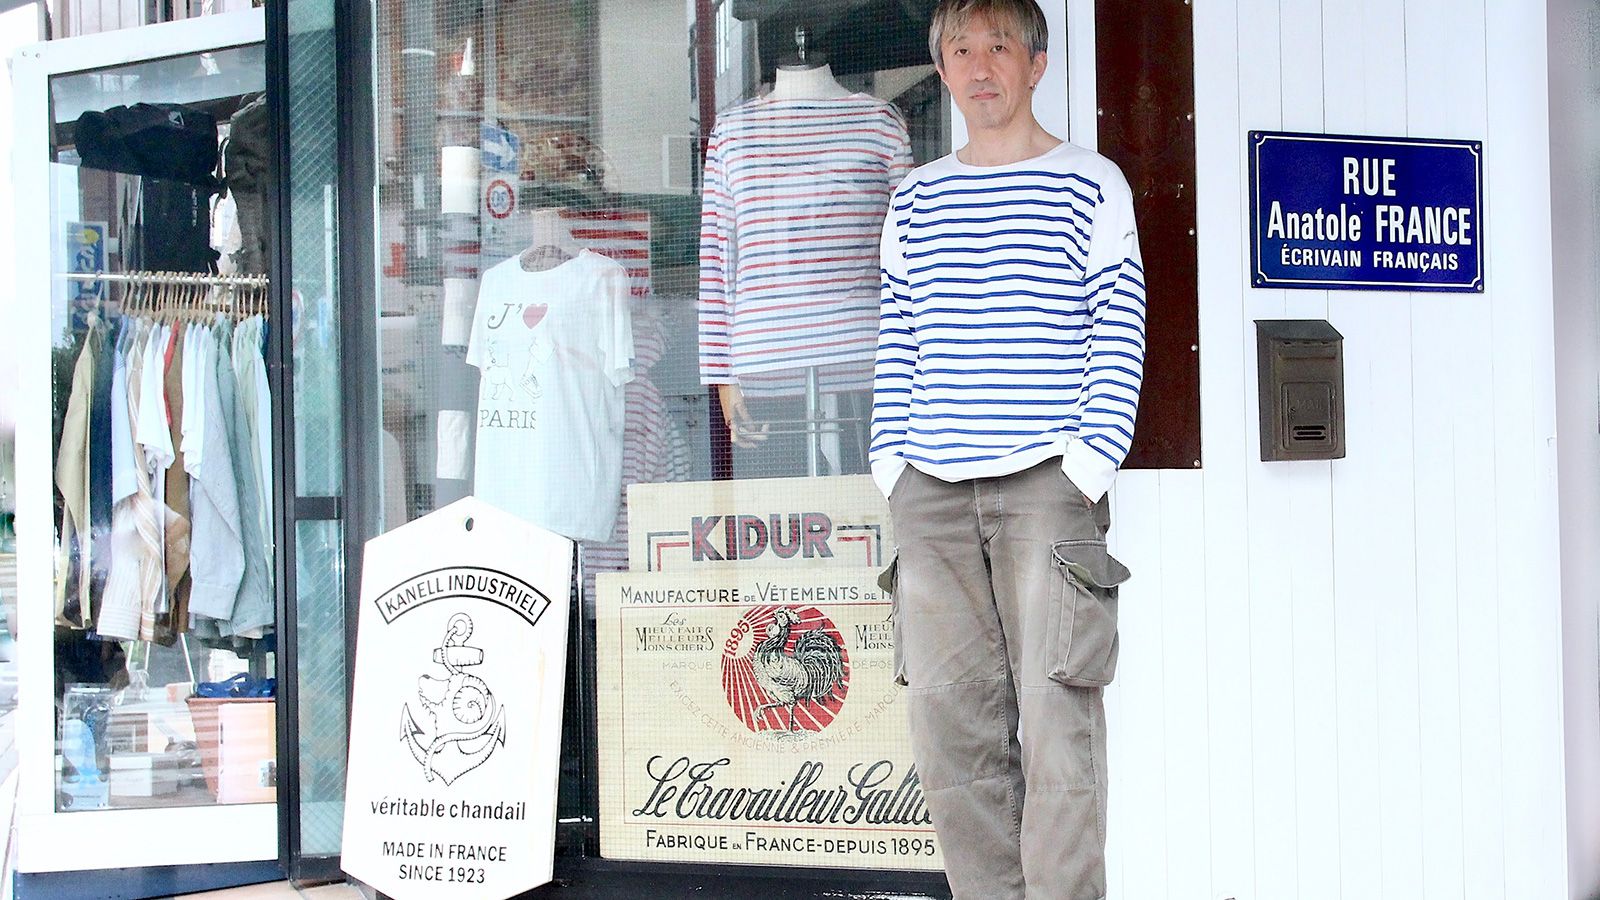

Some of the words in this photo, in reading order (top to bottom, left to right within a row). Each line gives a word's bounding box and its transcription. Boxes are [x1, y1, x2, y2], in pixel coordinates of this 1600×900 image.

[1343, 157, 1396, 196] RUE
[1267, 200, 1361, 242] Anatole
[1375, 204, 1472, 245] FRANCE
[1281, 244, 1361, 267] ÉCRIVAIN
[1373, 250, 1458, 272] FRANÇAIS
[480, 409, 536, 429] PARIS
[691, 512, 834, 561] KIDUR
[385, 577, 444, 615] KANELL
[448, 574, 538, 617] INDUSTRIEL
[621, 585, 740, 604] MANUFACTURE
[756, 582, 859, 602] VÊTEMENTS
[724, 619, 750, 657] 1895
[662, 661, 714, 672] MARQUE
[791, 743, 800, 754] &
[632, 755, 689, 818] Le
[675, 757, 848, 825] Travailleur
[371, 796, 445, 818] véritable
[449, 800, 526, 820] chandail
[382, 841, 425, 858] MADE
[429, 843, 444, 858] IN
[448, 844, 508, 862] FRANCE
[646, 829, 728, 851] FABRIQUE
[890, 838, 936, 857] 1895
[399, 864, 443, 881] SINCE
[448, 867, 485, 884] 1923
